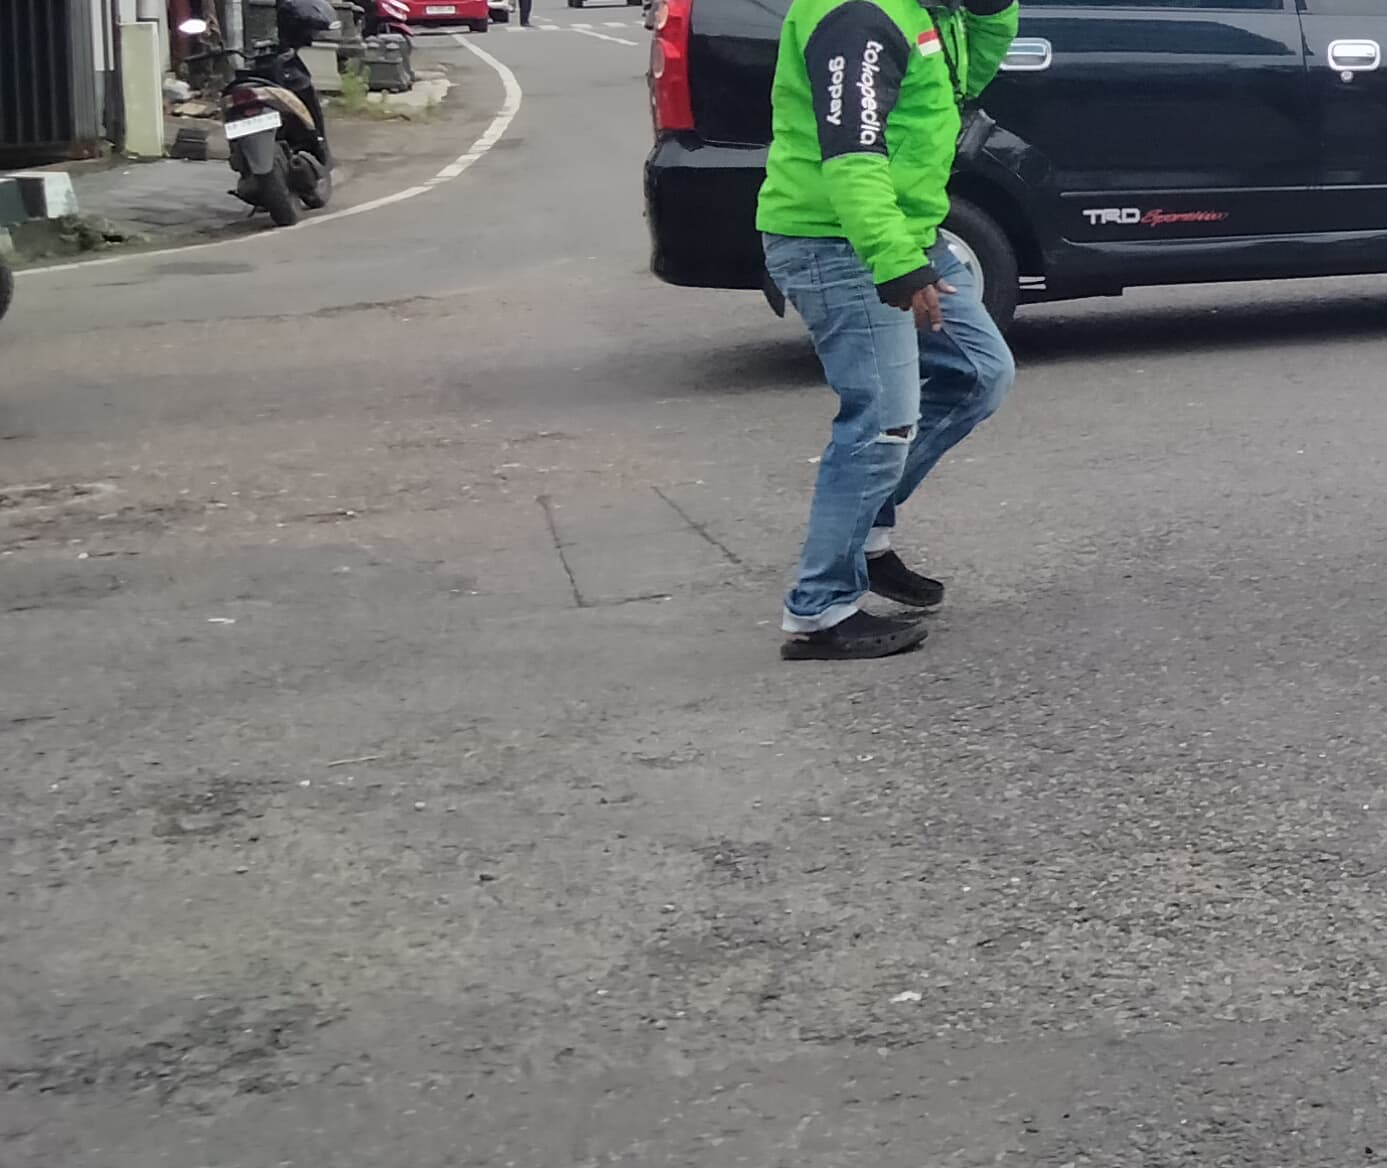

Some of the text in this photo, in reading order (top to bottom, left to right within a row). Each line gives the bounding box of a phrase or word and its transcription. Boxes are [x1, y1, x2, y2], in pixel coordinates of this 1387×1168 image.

[826, 55, 847, 126] gopay
[855, 39, 884, 146] tokopedia
[1083, 208, 1141, 225] TRD
